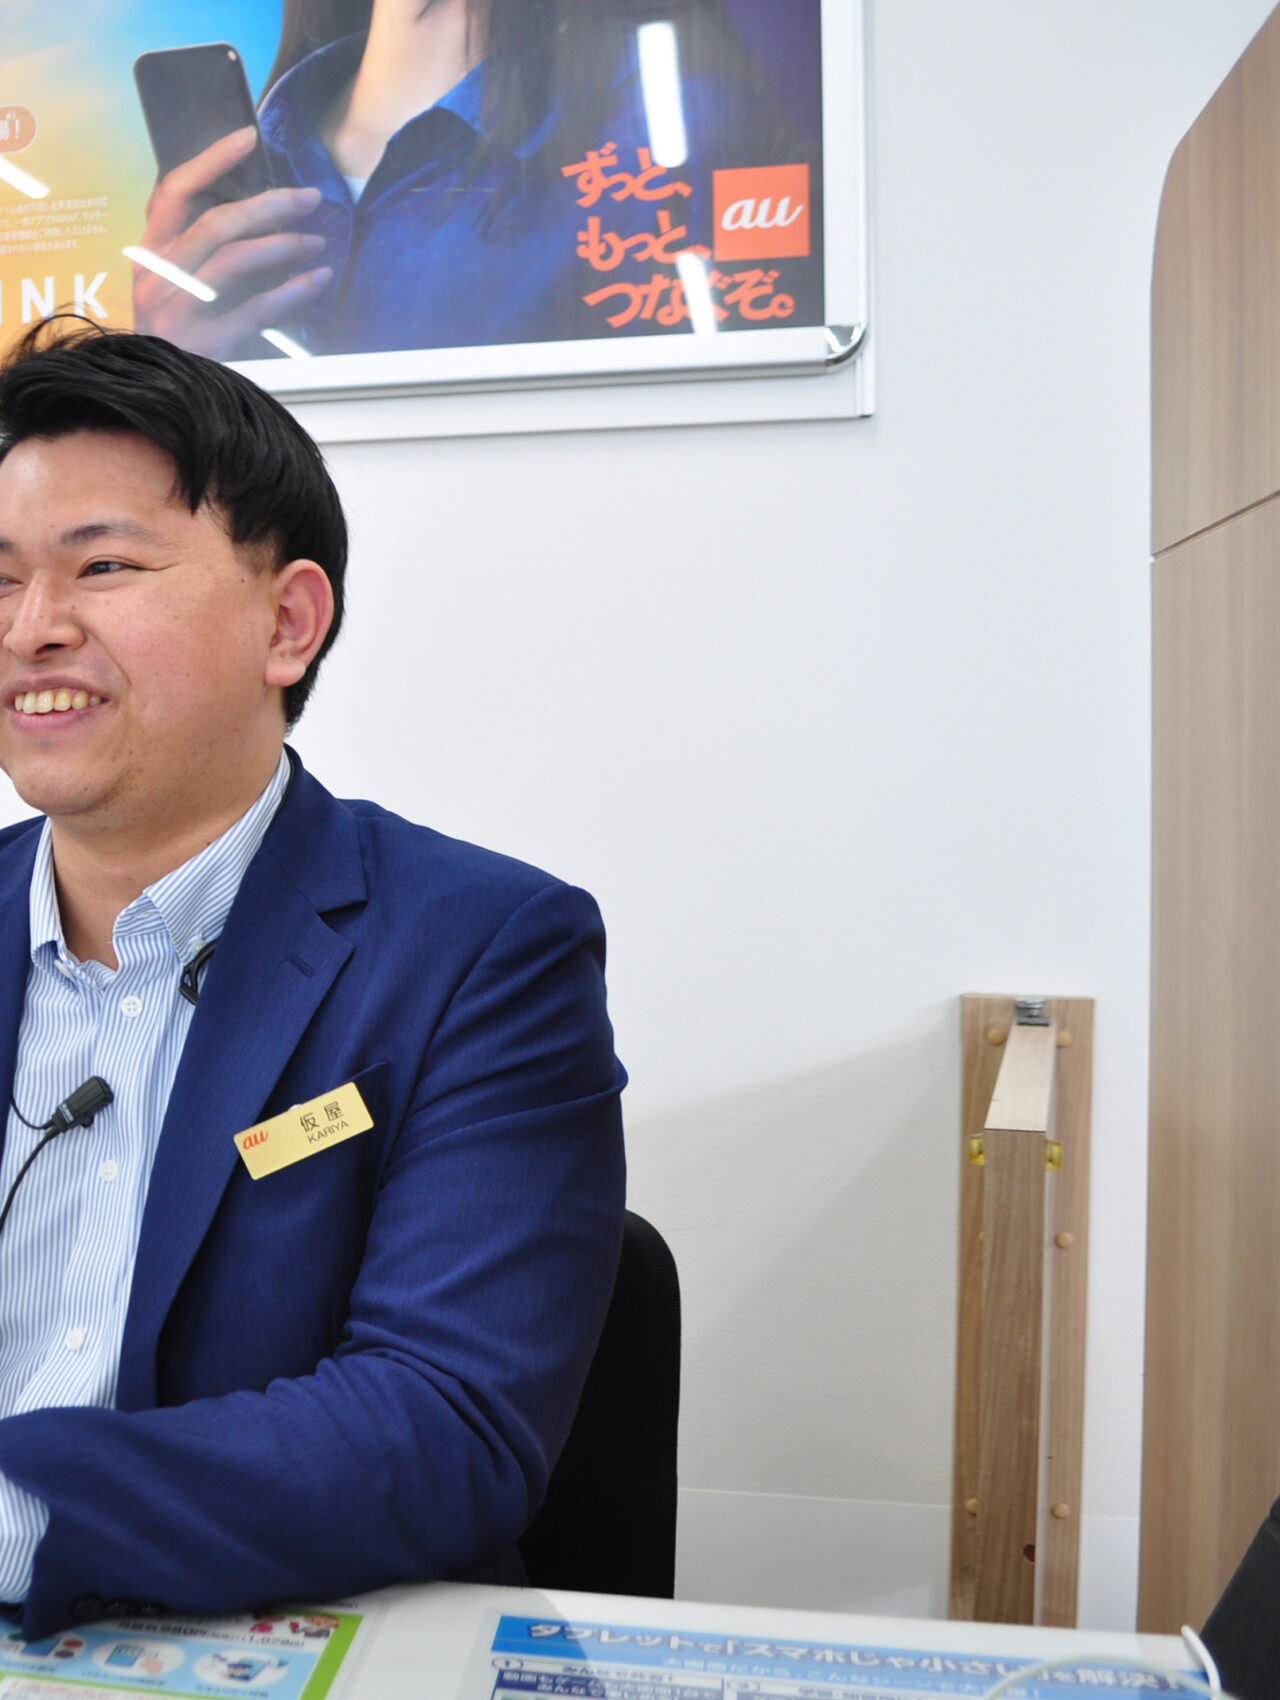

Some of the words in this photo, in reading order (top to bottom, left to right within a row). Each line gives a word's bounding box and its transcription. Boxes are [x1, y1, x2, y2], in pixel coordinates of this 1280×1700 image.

[561, 141, 693, 208] ずっと、
[720, 196, 804, 230] au
[577, 210, 712, 271] もっと、
[299, 1101, 343, 1132] 仮屋
[307, 1120, 350, 1144] KARIYA
[242, 1130, 269, 1150] au
